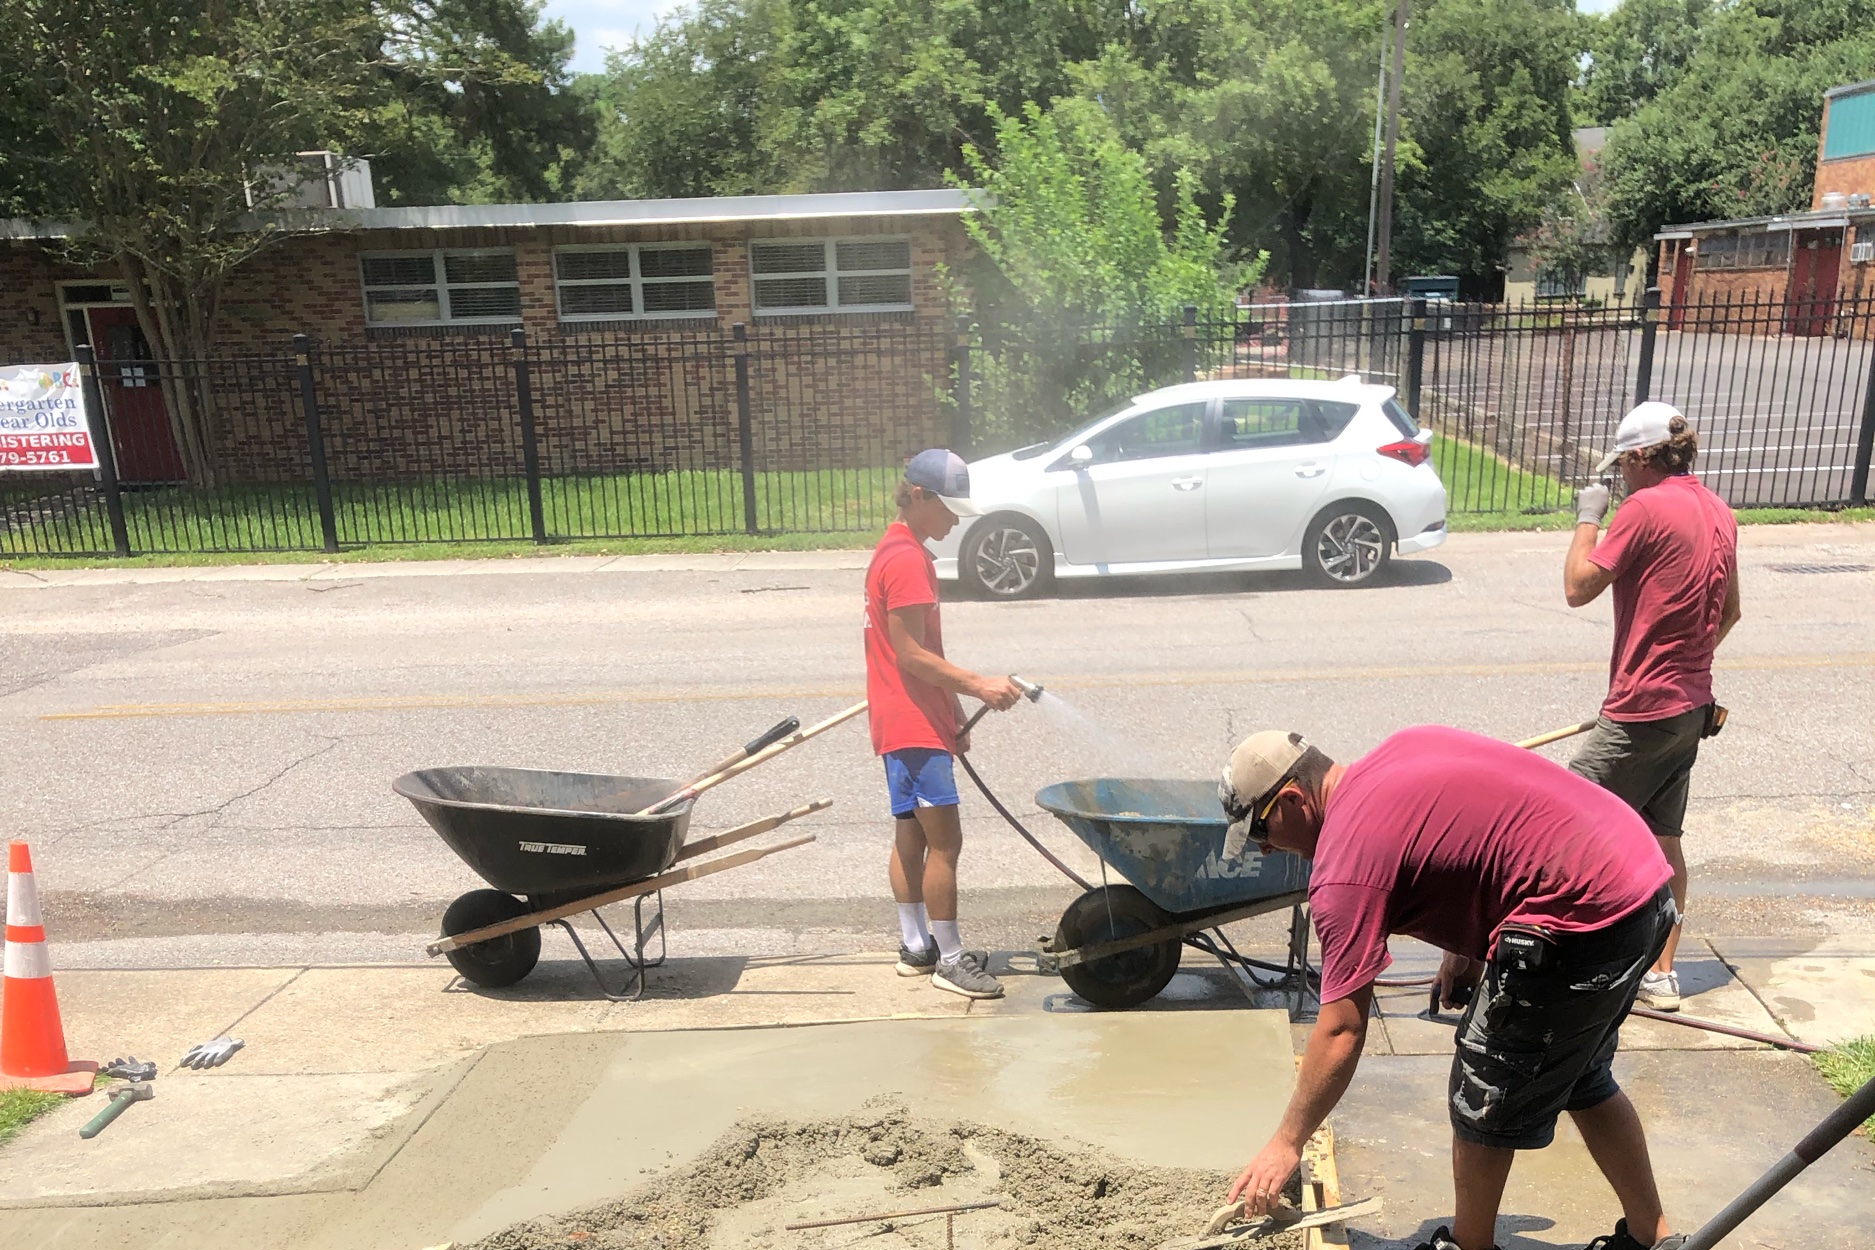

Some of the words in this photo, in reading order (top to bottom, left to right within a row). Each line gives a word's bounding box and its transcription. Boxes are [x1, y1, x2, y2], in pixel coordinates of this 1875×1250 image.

[0, 417, 30, 429] ear
[35, 411, 77, 428] Olds
[0, 434, 85, 448] ISTERING
[518, 841, 546, 853] TRUE
[545, 843, 587, 855] TEMPER
[1194, 848, 1263, 878] ACE
[1511, 938, 1535, 947] HUSKY
